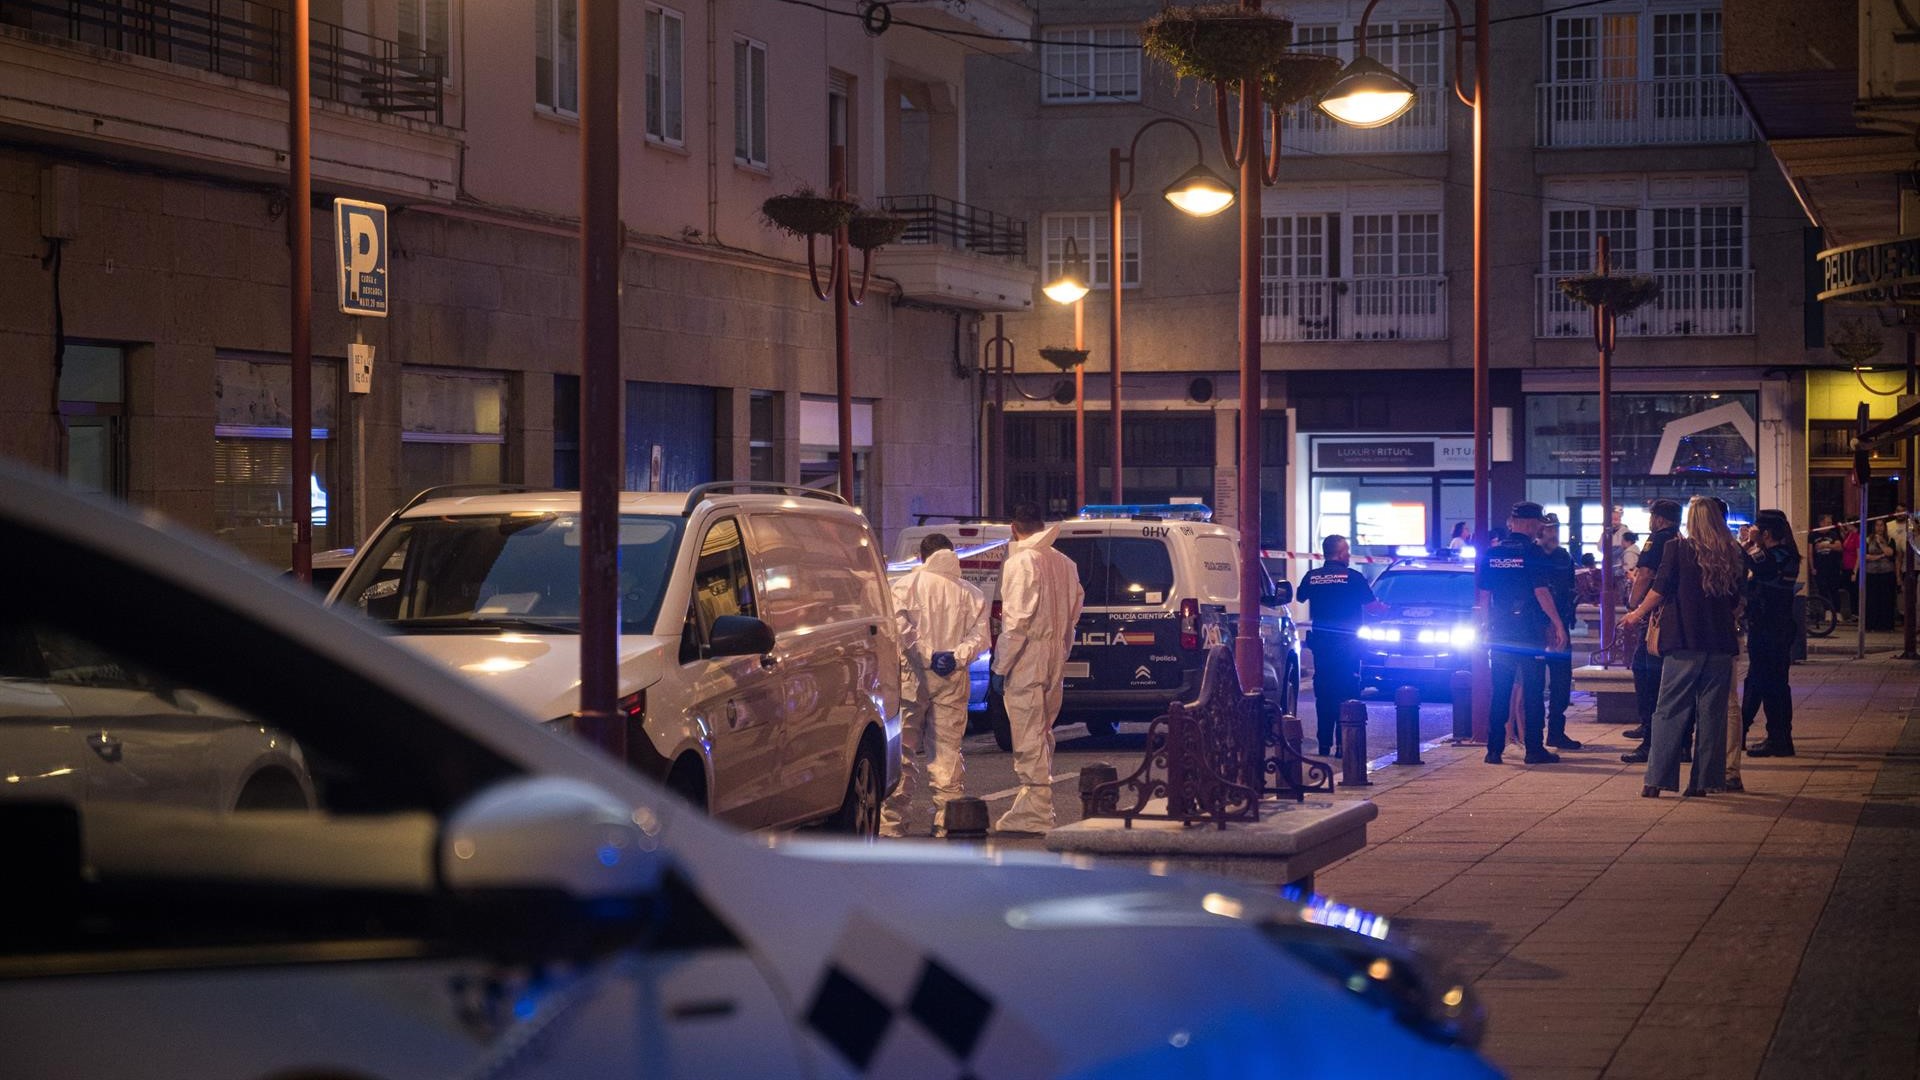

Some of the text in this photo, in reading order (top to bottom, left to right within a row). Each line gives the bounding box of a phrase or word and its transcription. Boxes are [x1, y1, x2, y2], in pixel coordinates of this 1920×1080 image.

[349, 212, 379, 301] P
[1825, 240, 1920, 291] PELUQUER
[1443, 447, 1474, 456] RITU
